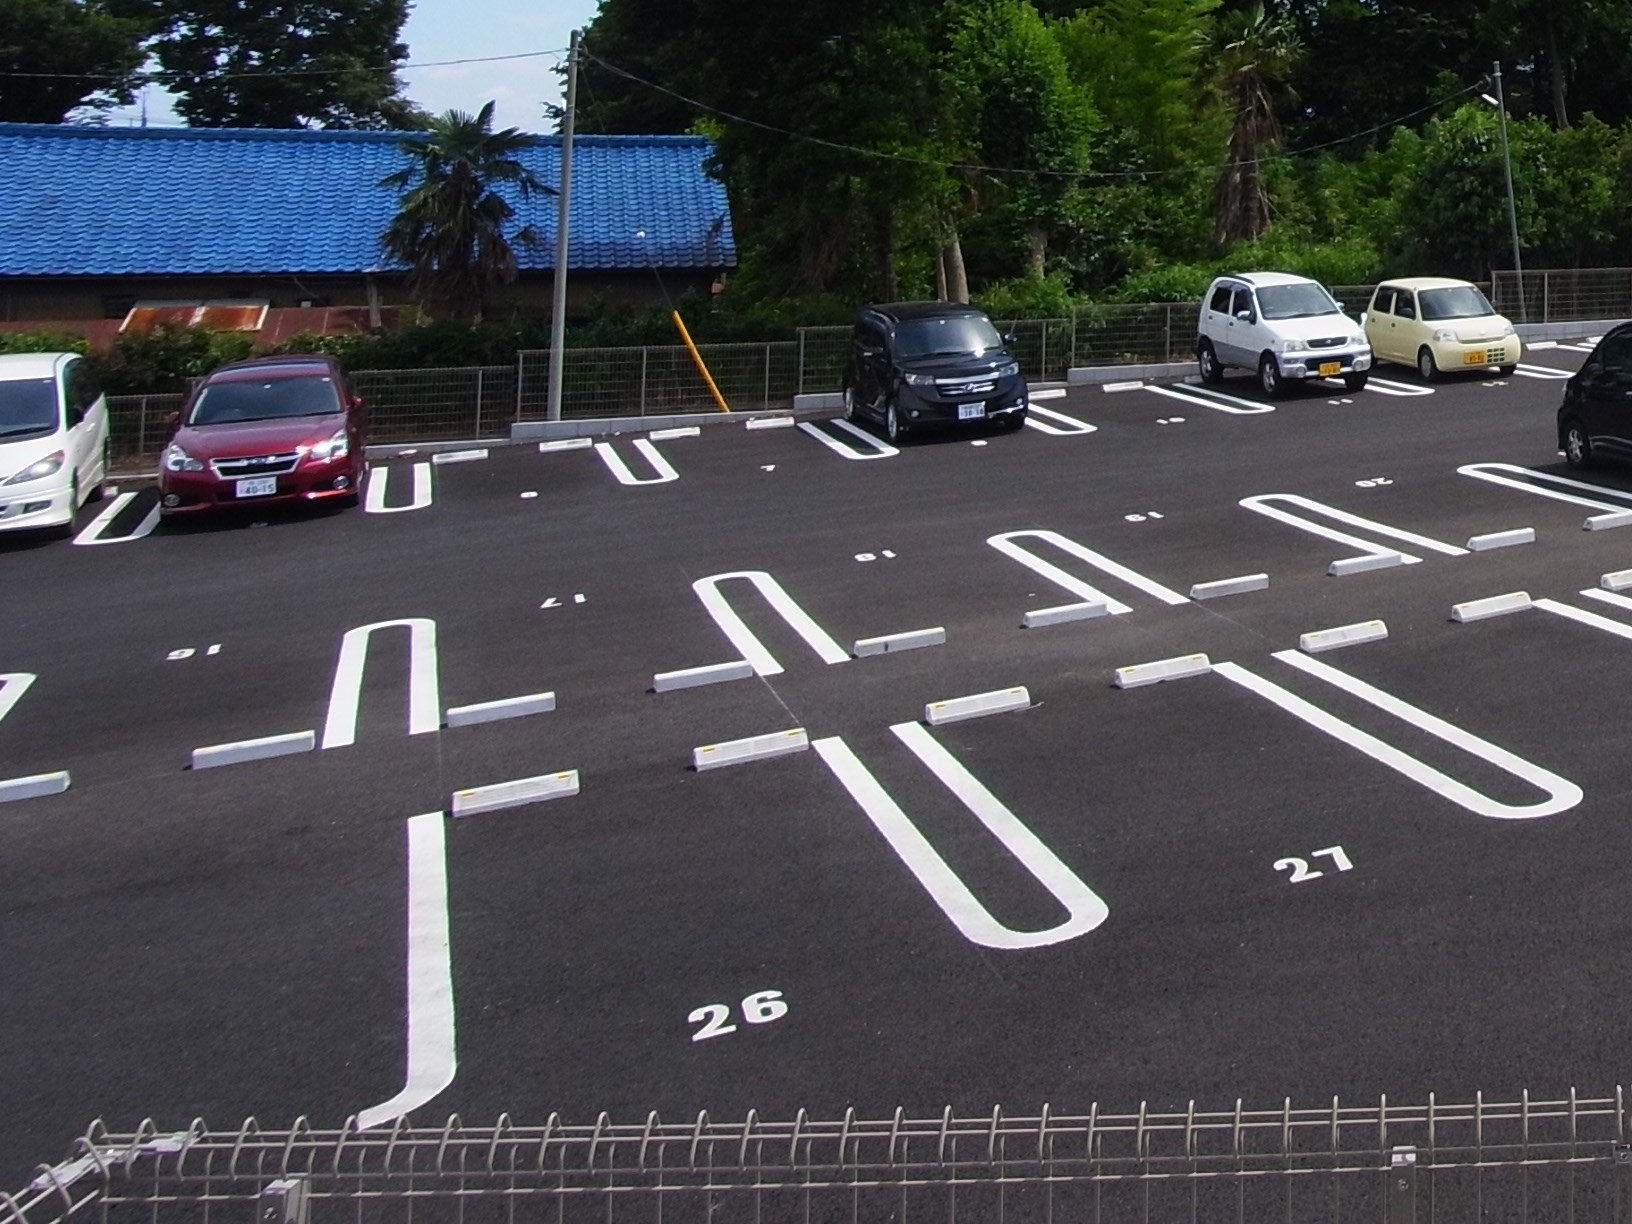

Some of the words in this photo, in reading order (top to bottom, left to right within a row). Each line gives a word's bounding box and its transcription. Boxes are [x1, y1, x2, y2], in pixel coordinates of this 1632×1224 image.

[1355, 477, 1393, 487] 20
[540, 593, 587, 609] 17
[166, 643, 222, 660] 16
[1273, 845, 1354, 883] 27
[687, 989, 788, 1042] 26
